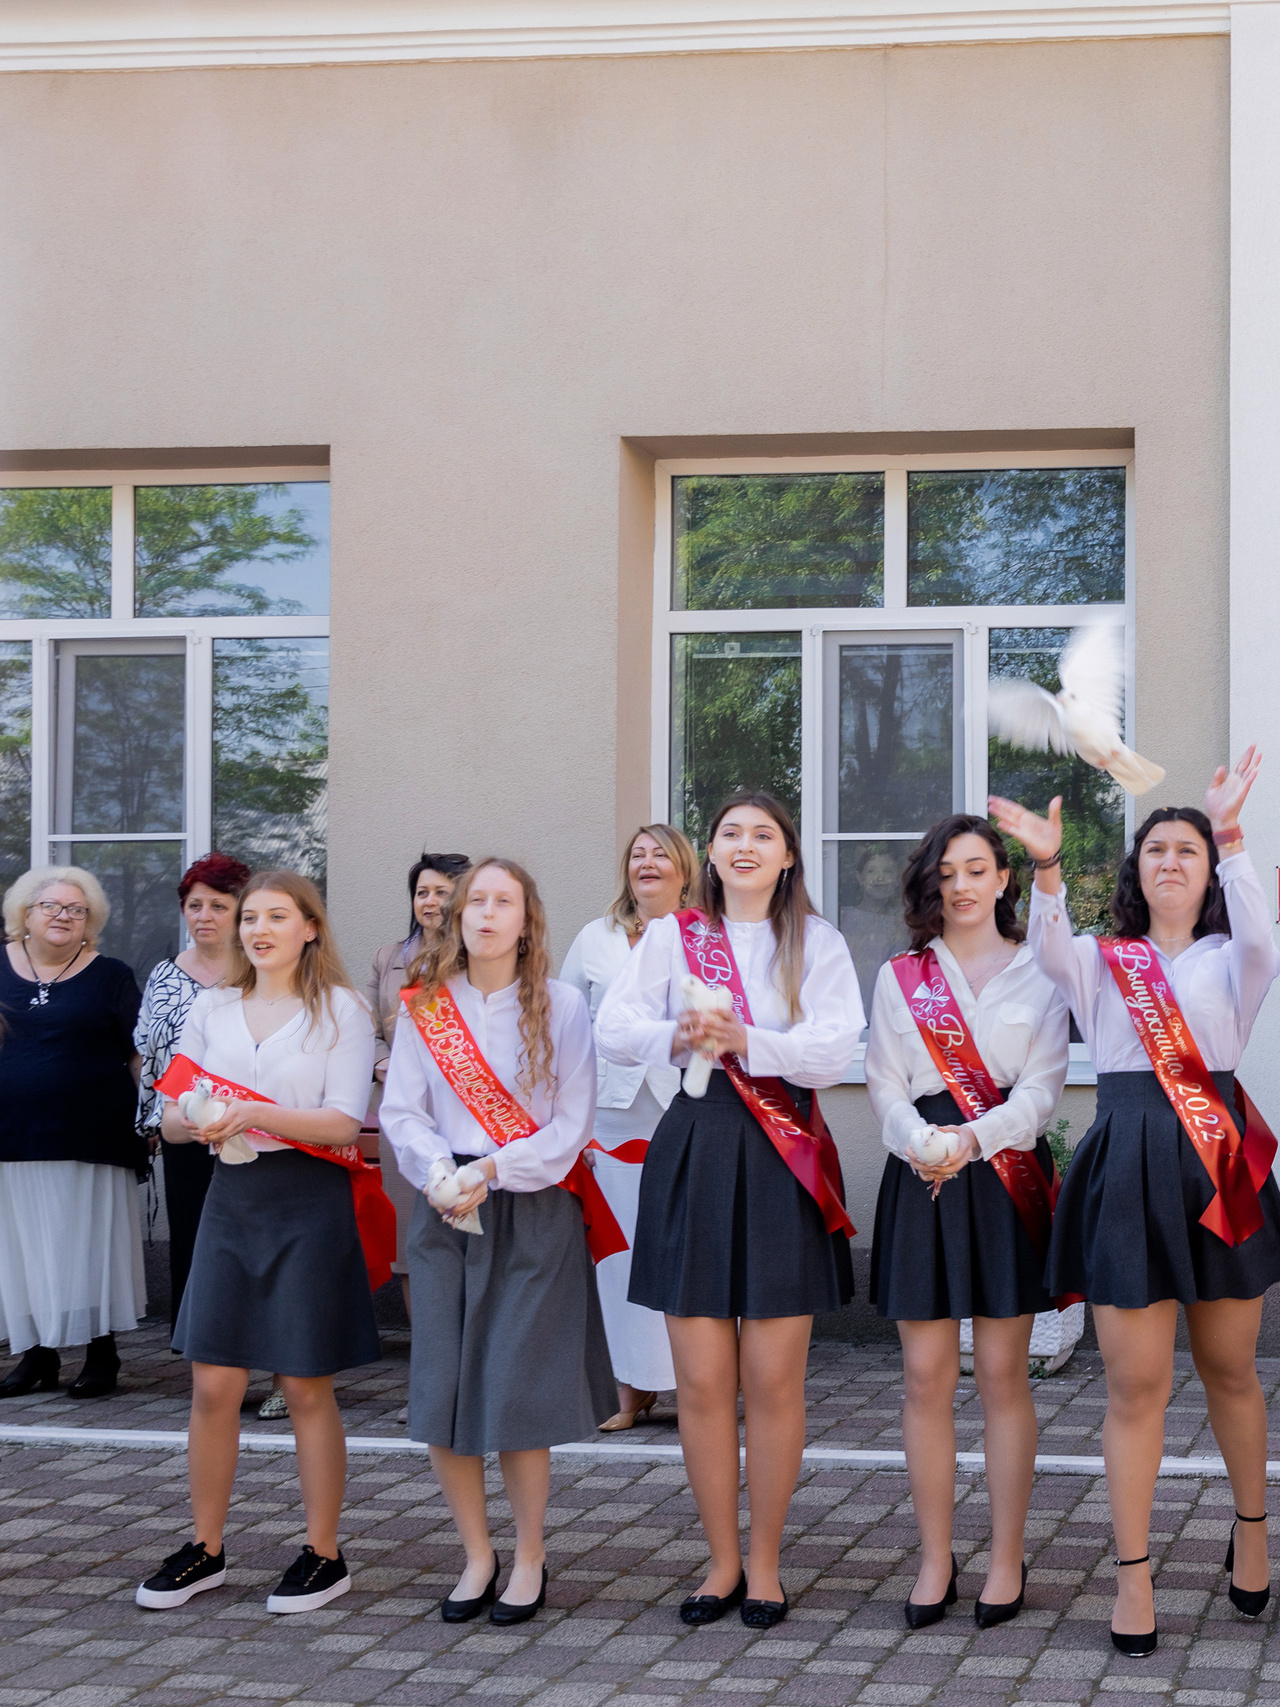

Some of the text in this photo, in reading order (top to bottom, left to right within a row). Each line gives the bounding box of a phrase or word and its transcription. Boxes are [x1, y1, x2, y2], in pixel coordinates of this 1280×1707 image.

[426, 1019, 525, 1144] Выпускник
[927, 1013, 986, 1119] Выпускн
[1113, 942, 1184, 1077] Выпускница
[1175, 1082, 1226, 1144] 2022
[750, 1085, 801, 1138] 2022
